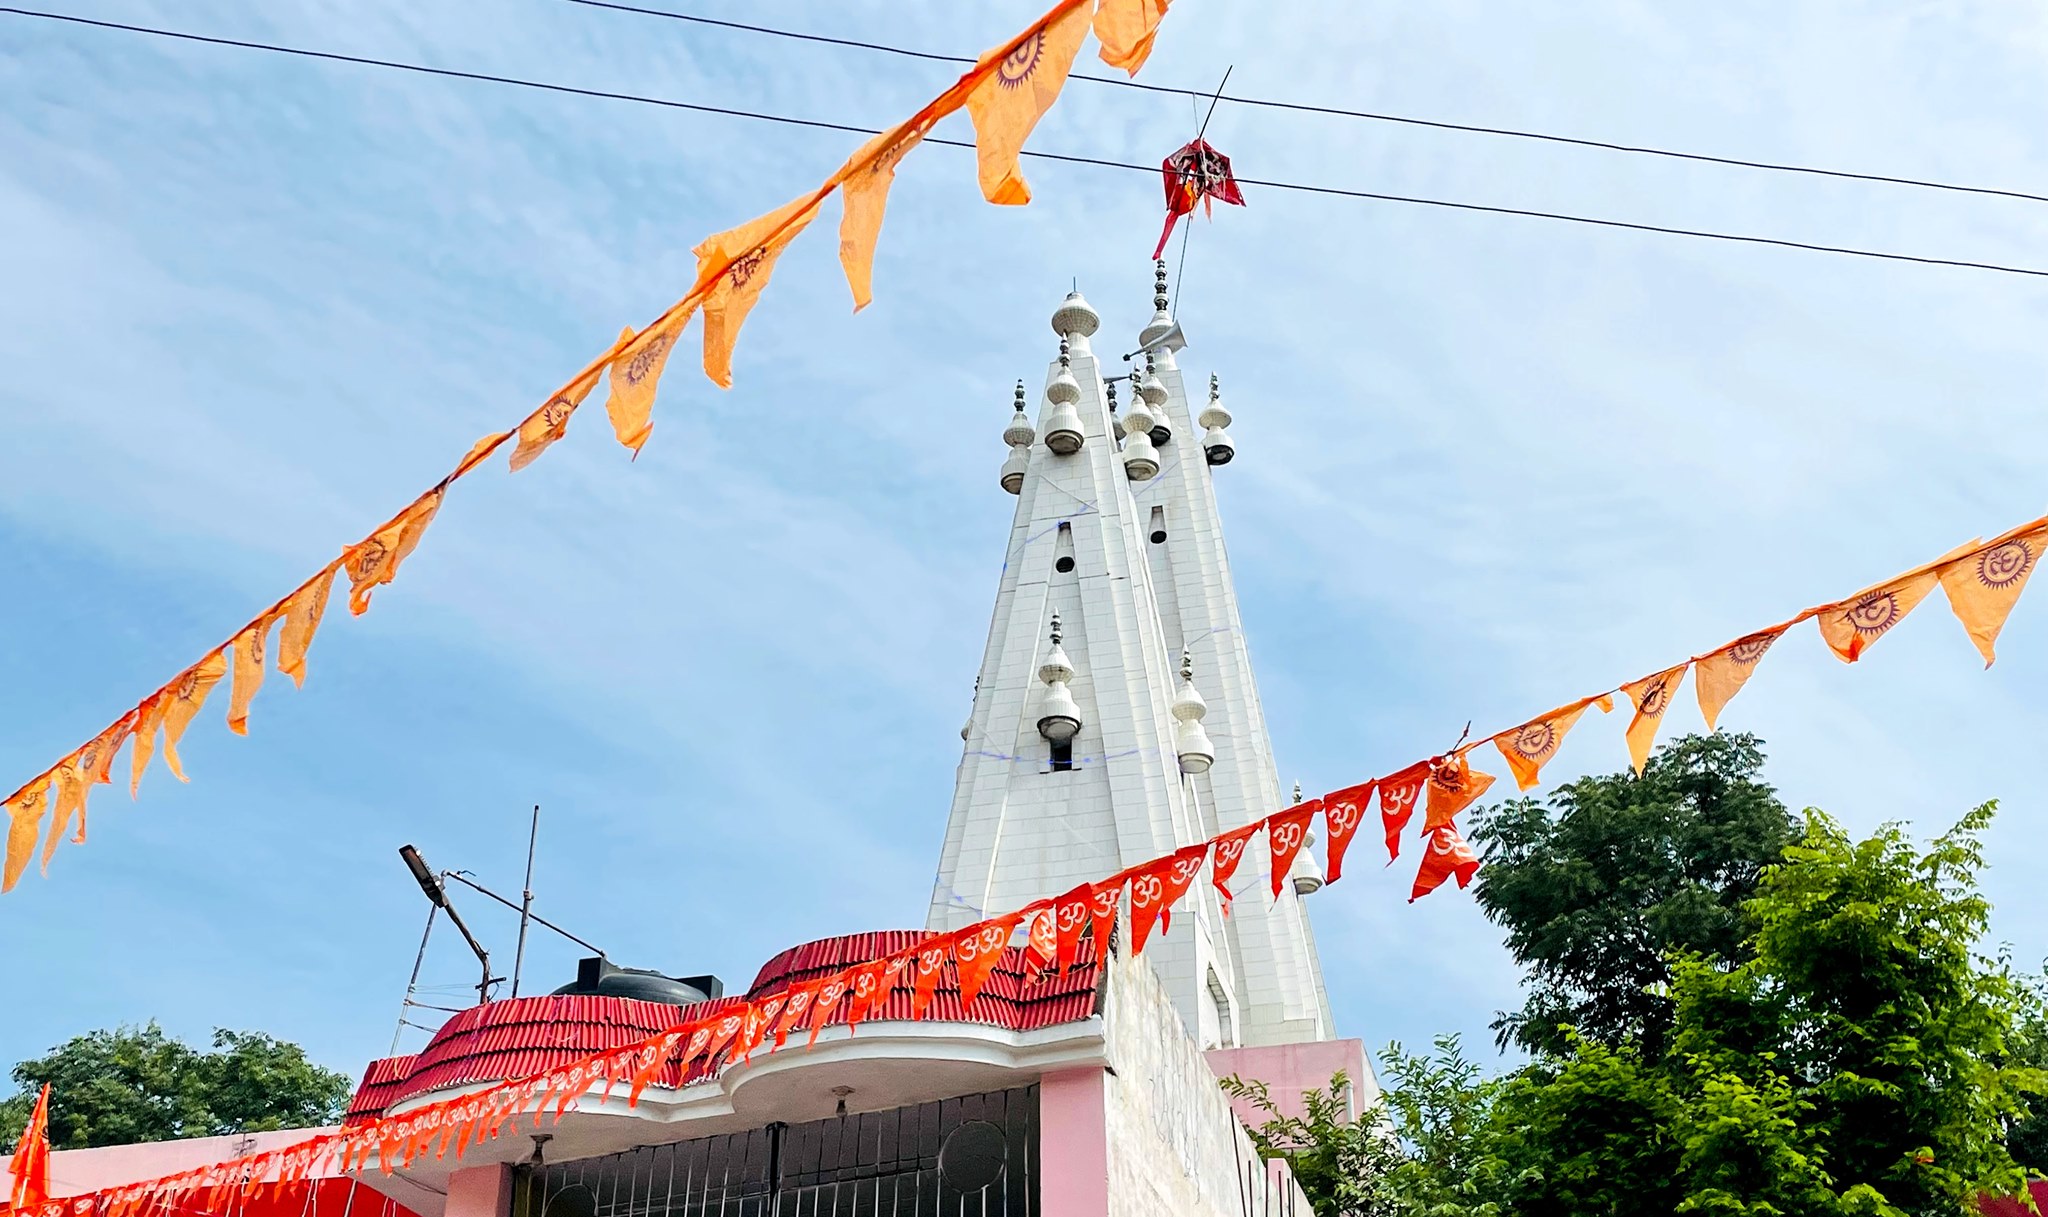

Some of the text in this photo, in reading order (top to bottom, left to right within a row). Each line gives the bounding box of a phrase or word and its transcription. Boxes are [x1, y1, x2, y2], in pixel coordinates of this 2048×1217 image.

[1383, 784, 1416, 815] ॐ
[1329, 802, 1357, 837] ॐ
[1272, 822, 1301, 856] ॐ
[1215, 838, 1244, 868] ॐ
[1170, 857, 1201, 885] ॐ
[1133, 873, 1161, 908] ॐ
[1057, 902, 1086, 932] ॐ
[980, 926, 1004, 954] ॐ
[920, 948, 943, 975] ॐ
[818, 981, 845, 1006] ॐ
[856, 972, 876, 998] ॐ
[759, 1000, 780, 1024] ॐ
[786, 991, 809, 1015] ॐ
[690, 1028, 709, 1051] ॐ
[717, 1015, 741, 1037] ॐ
[639, 1045, 657, 1069] ॐ
